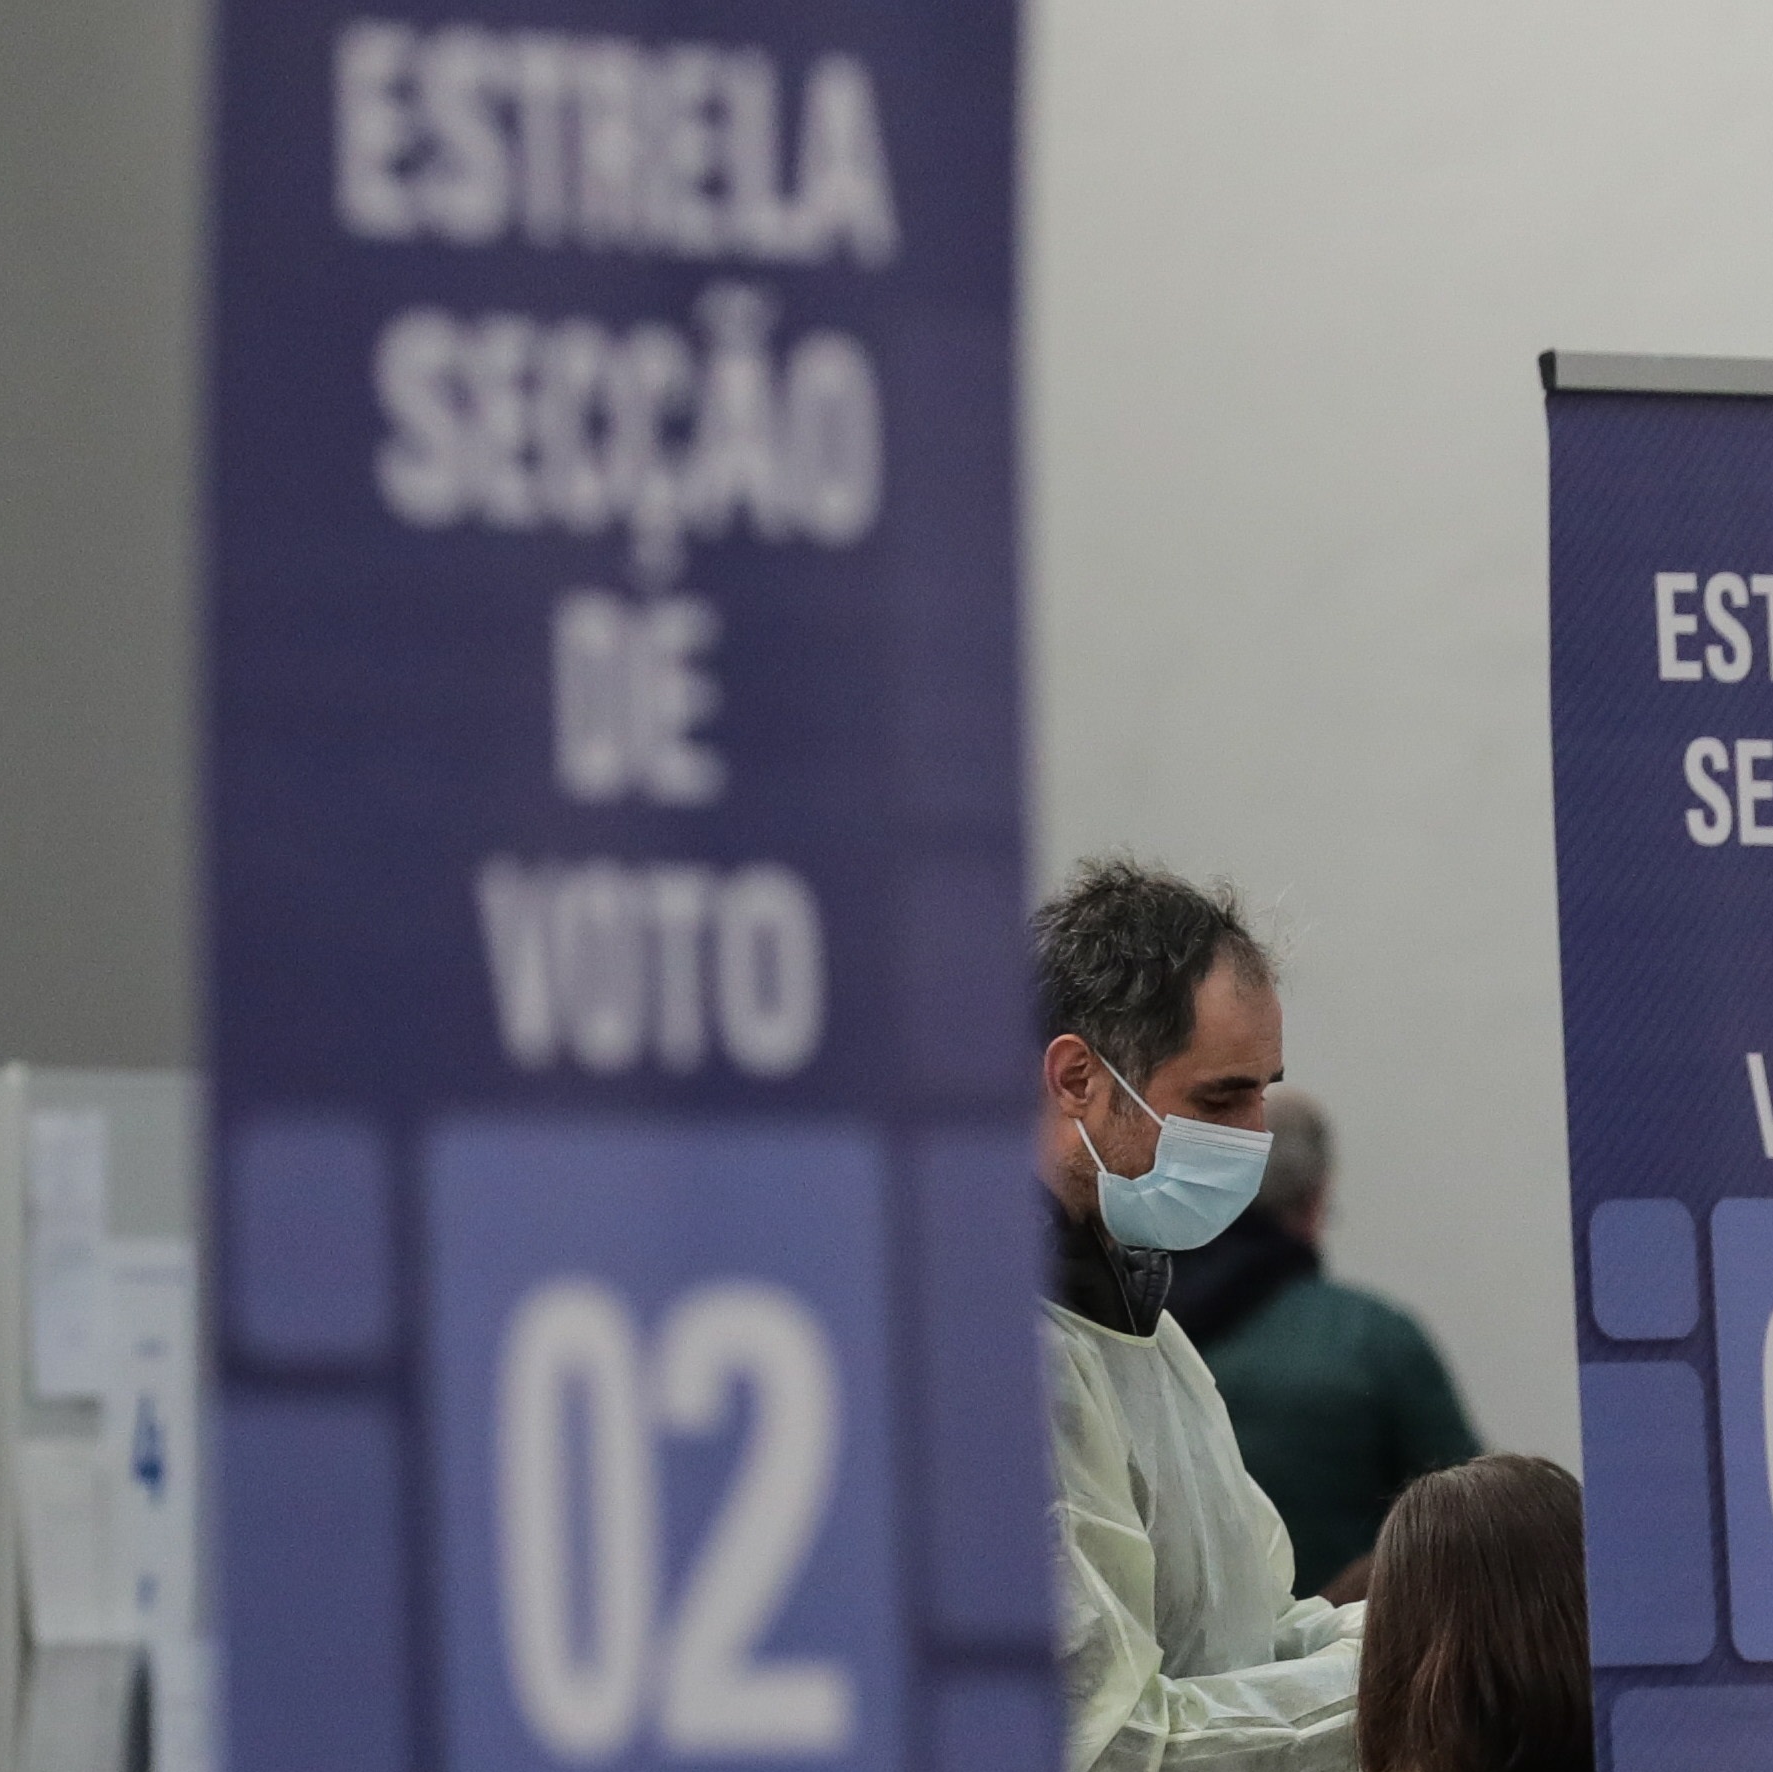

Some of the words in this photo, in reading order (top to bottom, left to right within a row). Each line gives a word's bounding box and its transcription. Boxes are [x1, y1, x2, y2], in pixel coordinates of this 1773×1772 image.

[336, 26, 896, 262] ESTRELA
[377, 287, 882, 576] SECÇÃO
[553, 592, 720, 803] DE
[477, 861, 822, 1074] VOTO
[499, 1280, 851, 1758] 02
